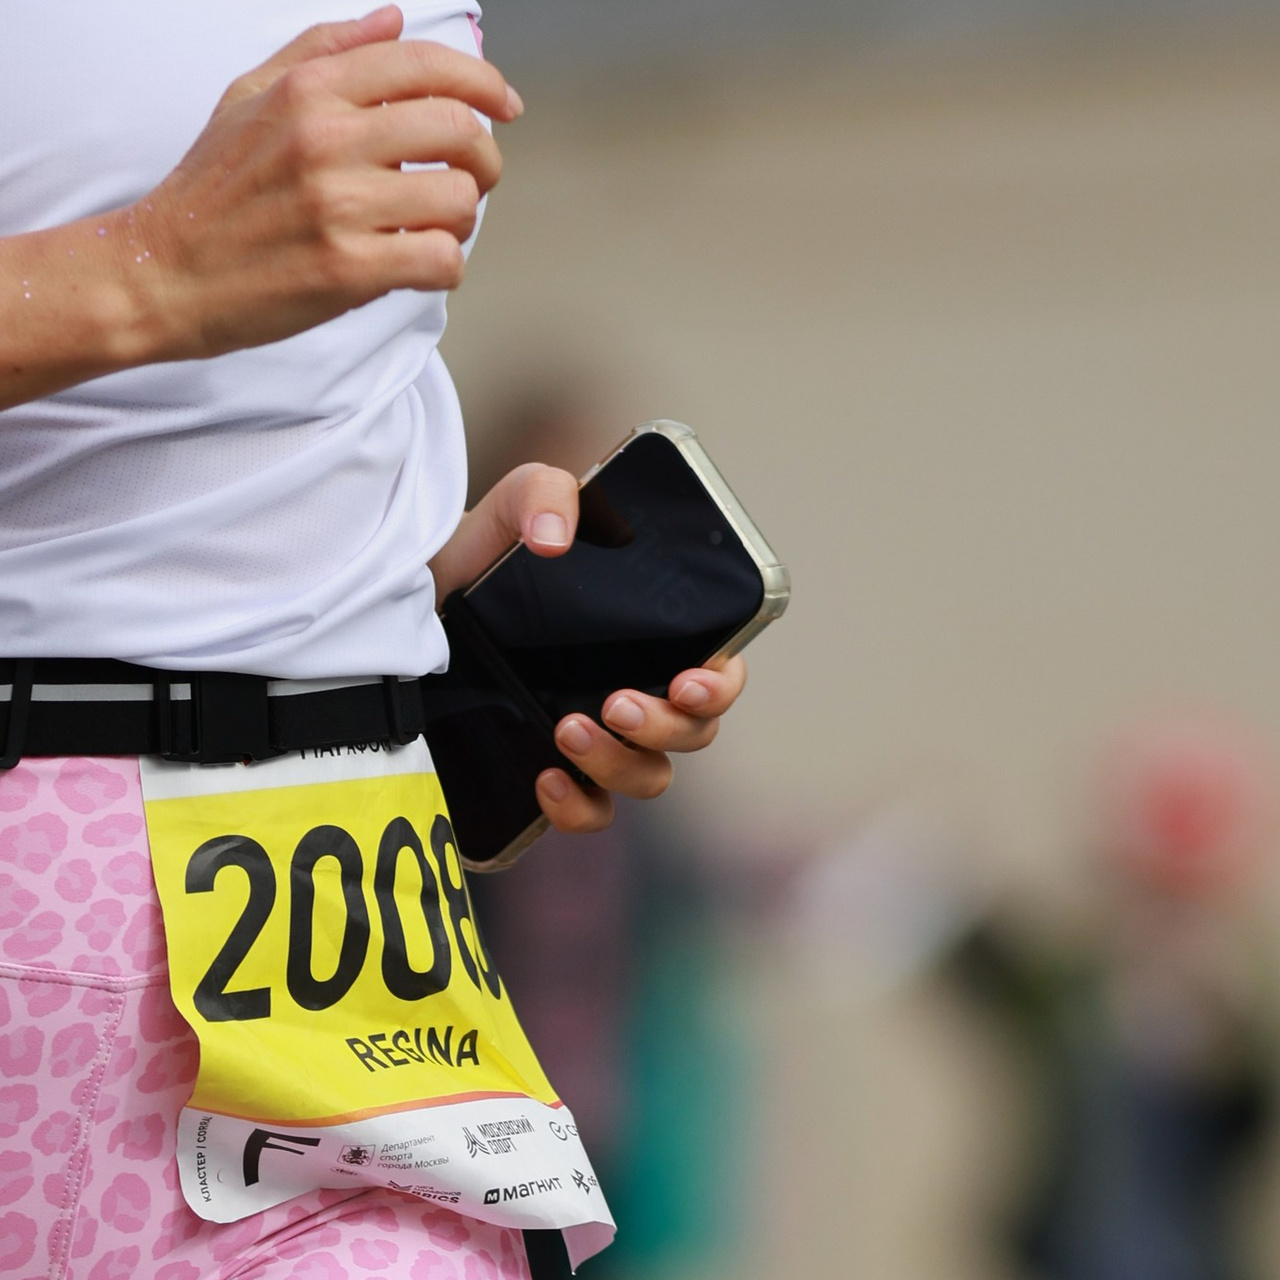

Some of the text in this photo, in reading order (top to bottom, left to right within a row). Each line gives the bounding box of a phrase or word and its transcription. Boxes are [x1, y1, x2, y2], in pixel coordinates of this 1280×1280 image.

[345, 1025, 480, 1073] REGINA
[476, 1114, 535, 1139] МОСКОВСКИЙ
[381, 1135, 435, 1153] Департамент
[486, 1137, 518, 1155] СПОРТ
[243, 1128, 321, 1187] F
[377, 1156, 450, 1170] города Москвы
[380, 1152, 413, 1161] спорта
[196, 1152, 212, 1202] КЛАСТЕР
